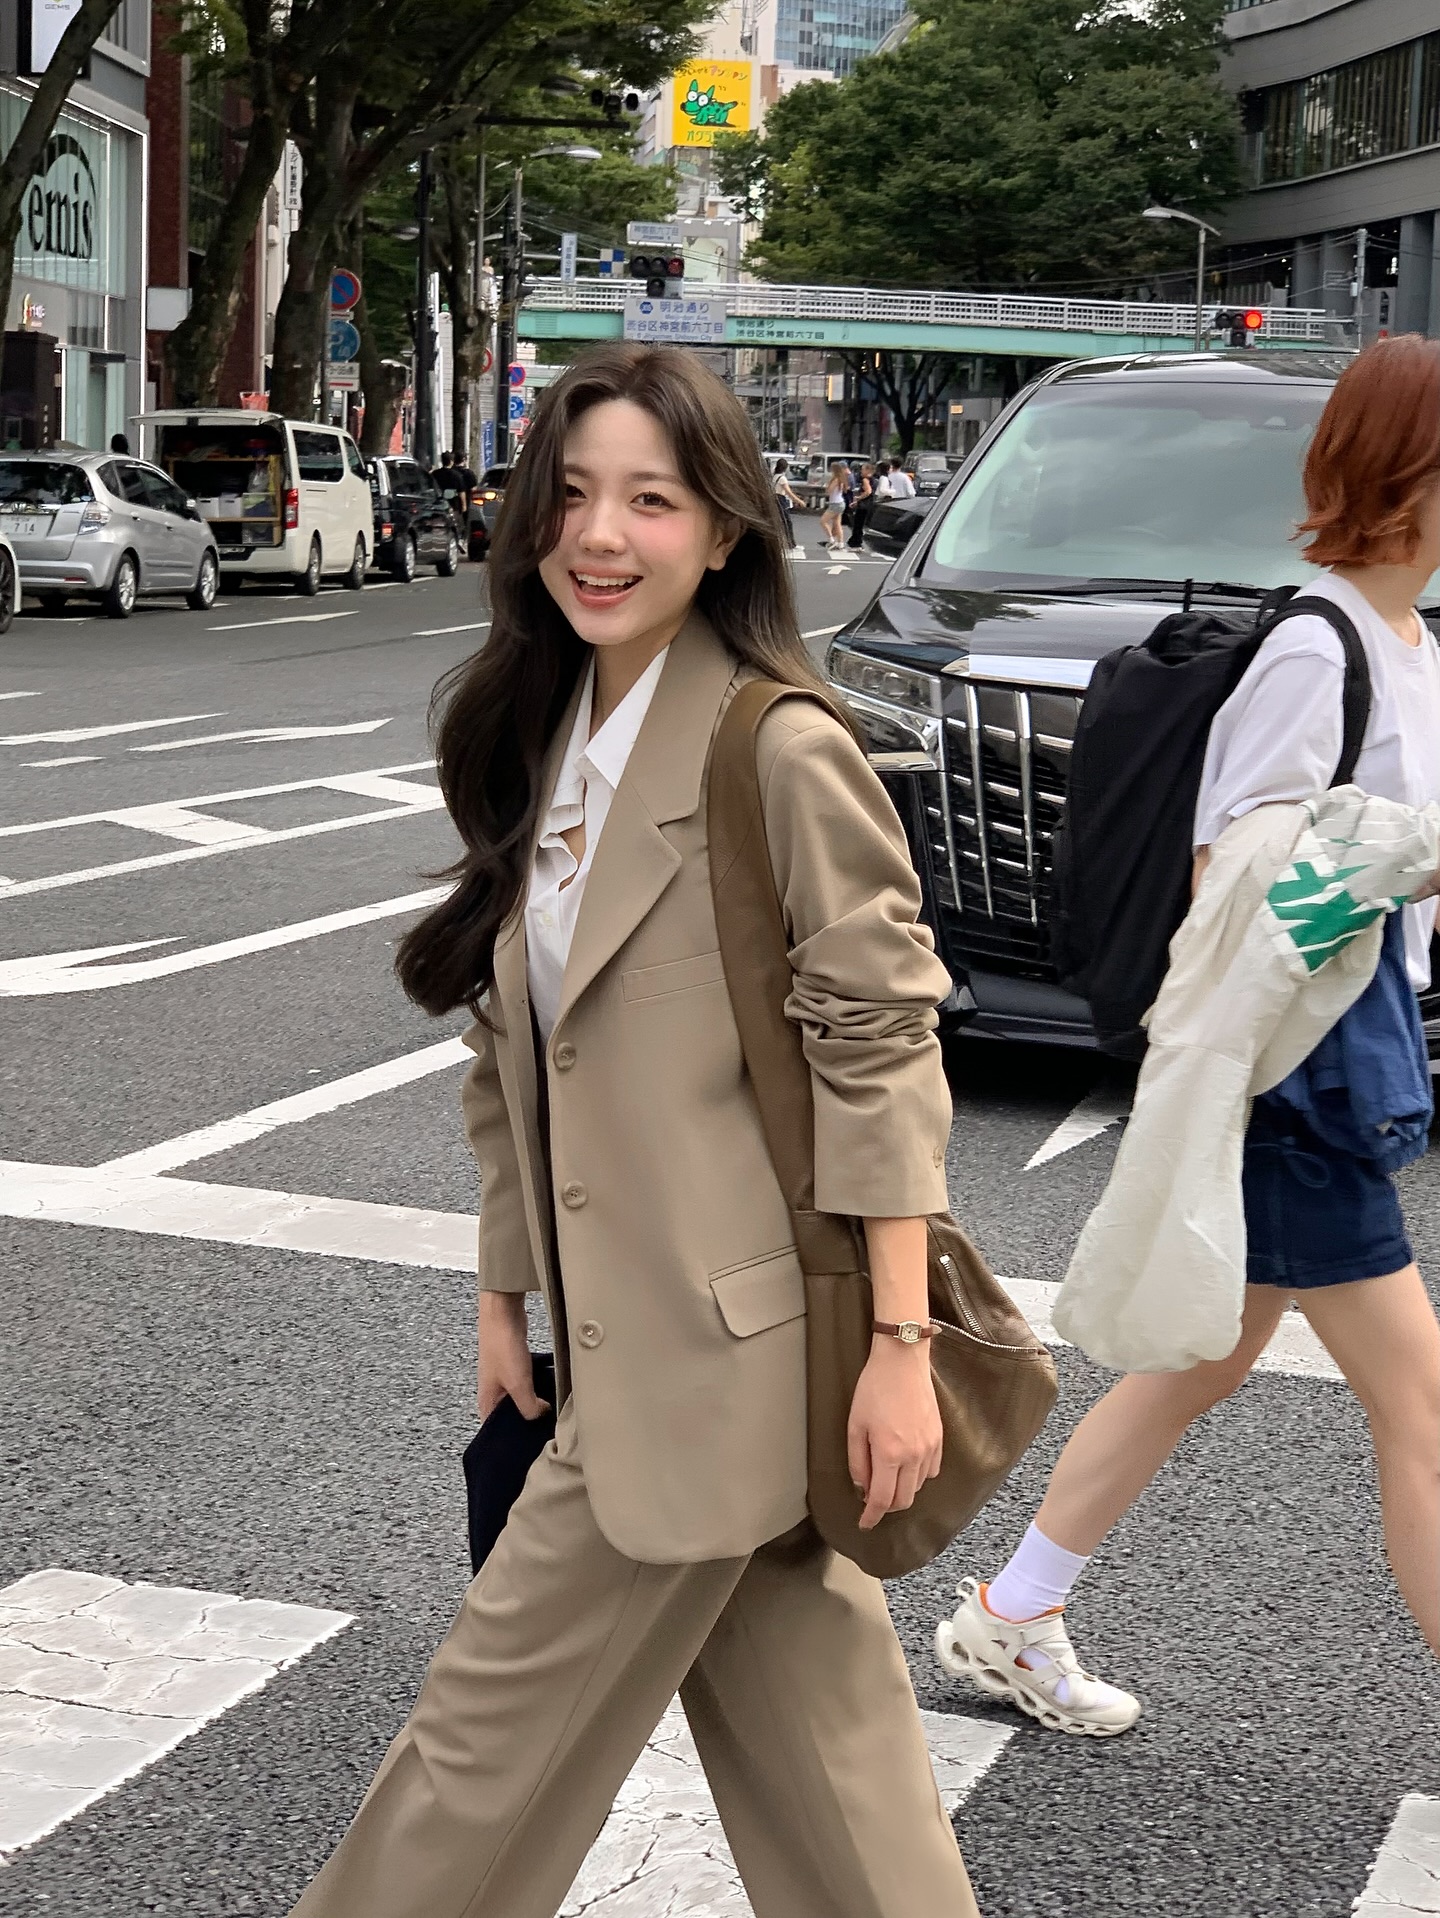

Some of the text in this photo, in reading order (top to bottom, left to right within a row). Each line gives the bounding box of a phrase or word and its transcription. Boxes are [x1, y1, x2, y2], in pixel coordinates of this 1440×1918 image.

[660, 301, 709, 314] 明治通り
[627, 320, 723, 333] 渋谷区神宮前六丁目
